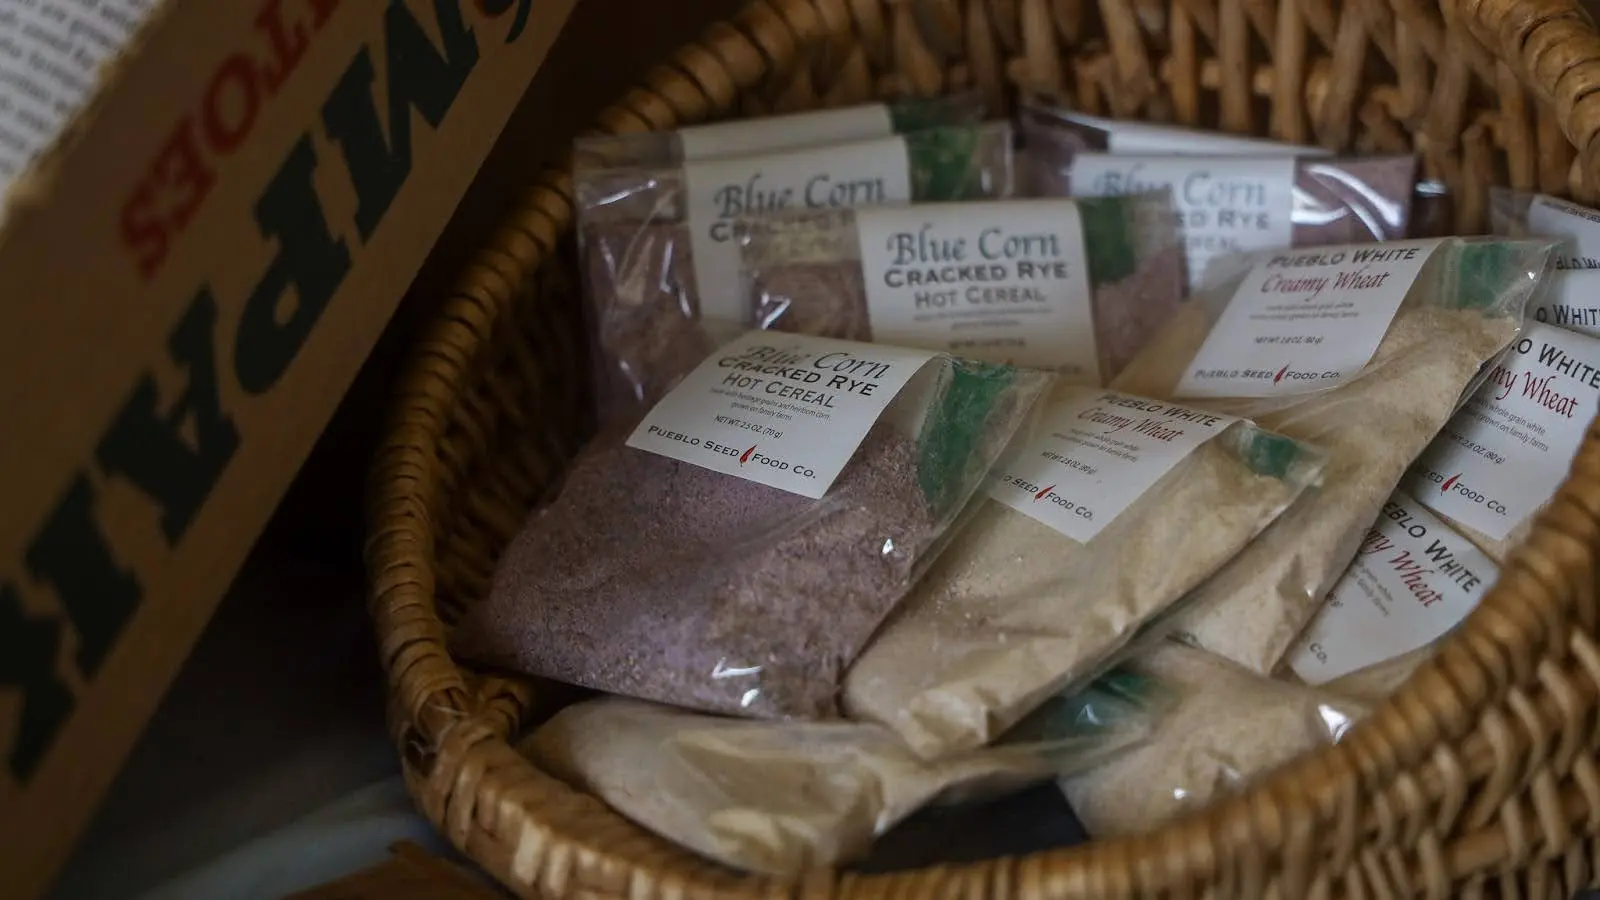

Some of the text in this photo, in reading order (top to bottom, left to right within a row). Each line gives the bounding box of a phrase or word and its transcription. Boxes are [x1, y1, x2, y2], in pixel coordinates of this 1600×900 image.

[714, 170, 887, 219] Blue Corn
[886, 223, 967, 267] Blue
[979, 226, 1061, 262] Corn
[1266, 246, 1422, 269] PUEBLO WHITE
[884, 261, 1069, 289] CRACKED RYE
[1260, 264, 1391, 303] Creamy Wheat
[914, 285, 1047, 309] HOT CEREAL
[1553, 303, 1600, 326] WHIT
[717, 356, 880, 397] CRACKED RYE
[814, 350, 892, 381] Corn
[1194, 369, 1239, 379] PUEBLO
[1241, 369, 1273, 379] SEED
[1284, 371, 1319, 380] FOOD
[1537, 342, 1600, 391] WHITE
[0, 0, 530, 785] MPAK
[721, 371, 835, 410] HOT CEREAL
[1522, 370, 1579, 420] Wheat
[714, 415, 729, 425] NET
[1077, 407, 1132, 436] Creamy
[1133, 418, 1185, 444] Wheat
[1095, 393, 1224, 429] PUEBLO WHITE
[647, 425, 818, 480] PUEBLO SEED FOOD CO.
[1011, 478, 1040, 494] SEED
[1045, 491, 1075, 511] FOOD
[1075, 505, 1096, 522] CO.
[1452, 482, 1486, 504] FOOD
[1487, 500, 1508, 516] CO.
[1383, 501, 1427, 539] EBLO
[1424, 539, 1482, 594] WHITE
[1388, 549, 1445, 608] Wheat
